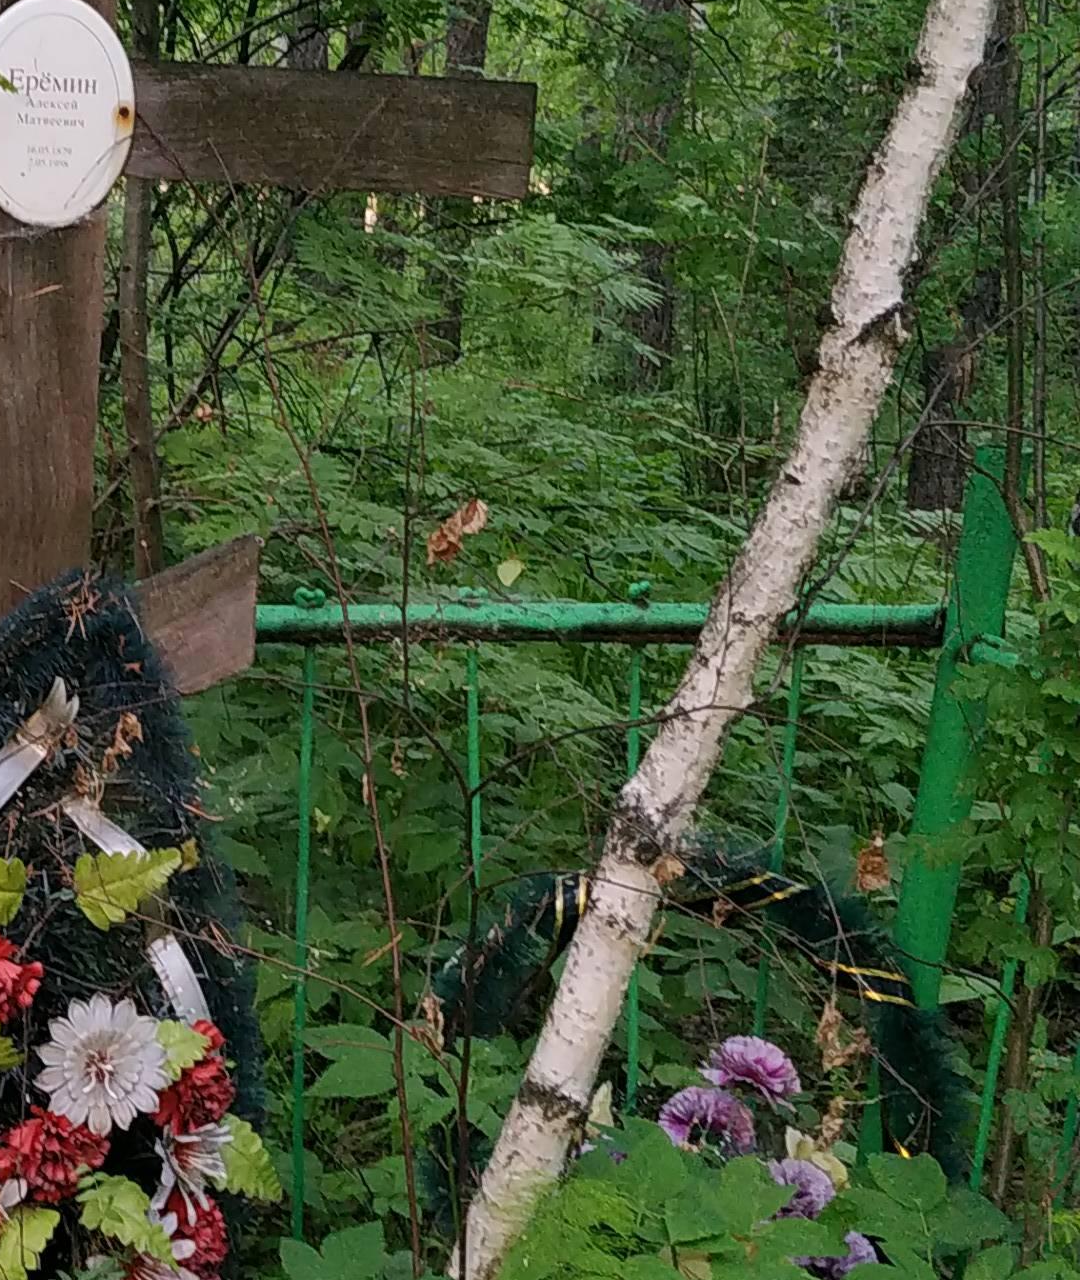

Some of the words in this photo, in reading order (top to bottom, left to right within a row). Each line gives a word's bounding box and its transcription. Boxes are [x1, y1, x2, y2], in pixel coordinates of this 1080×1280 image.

[9, 67, 97, 96] Ерёмин
[25, 96, 78, 111] Алексей
[17, 112, 85, 129] Матвеевич
